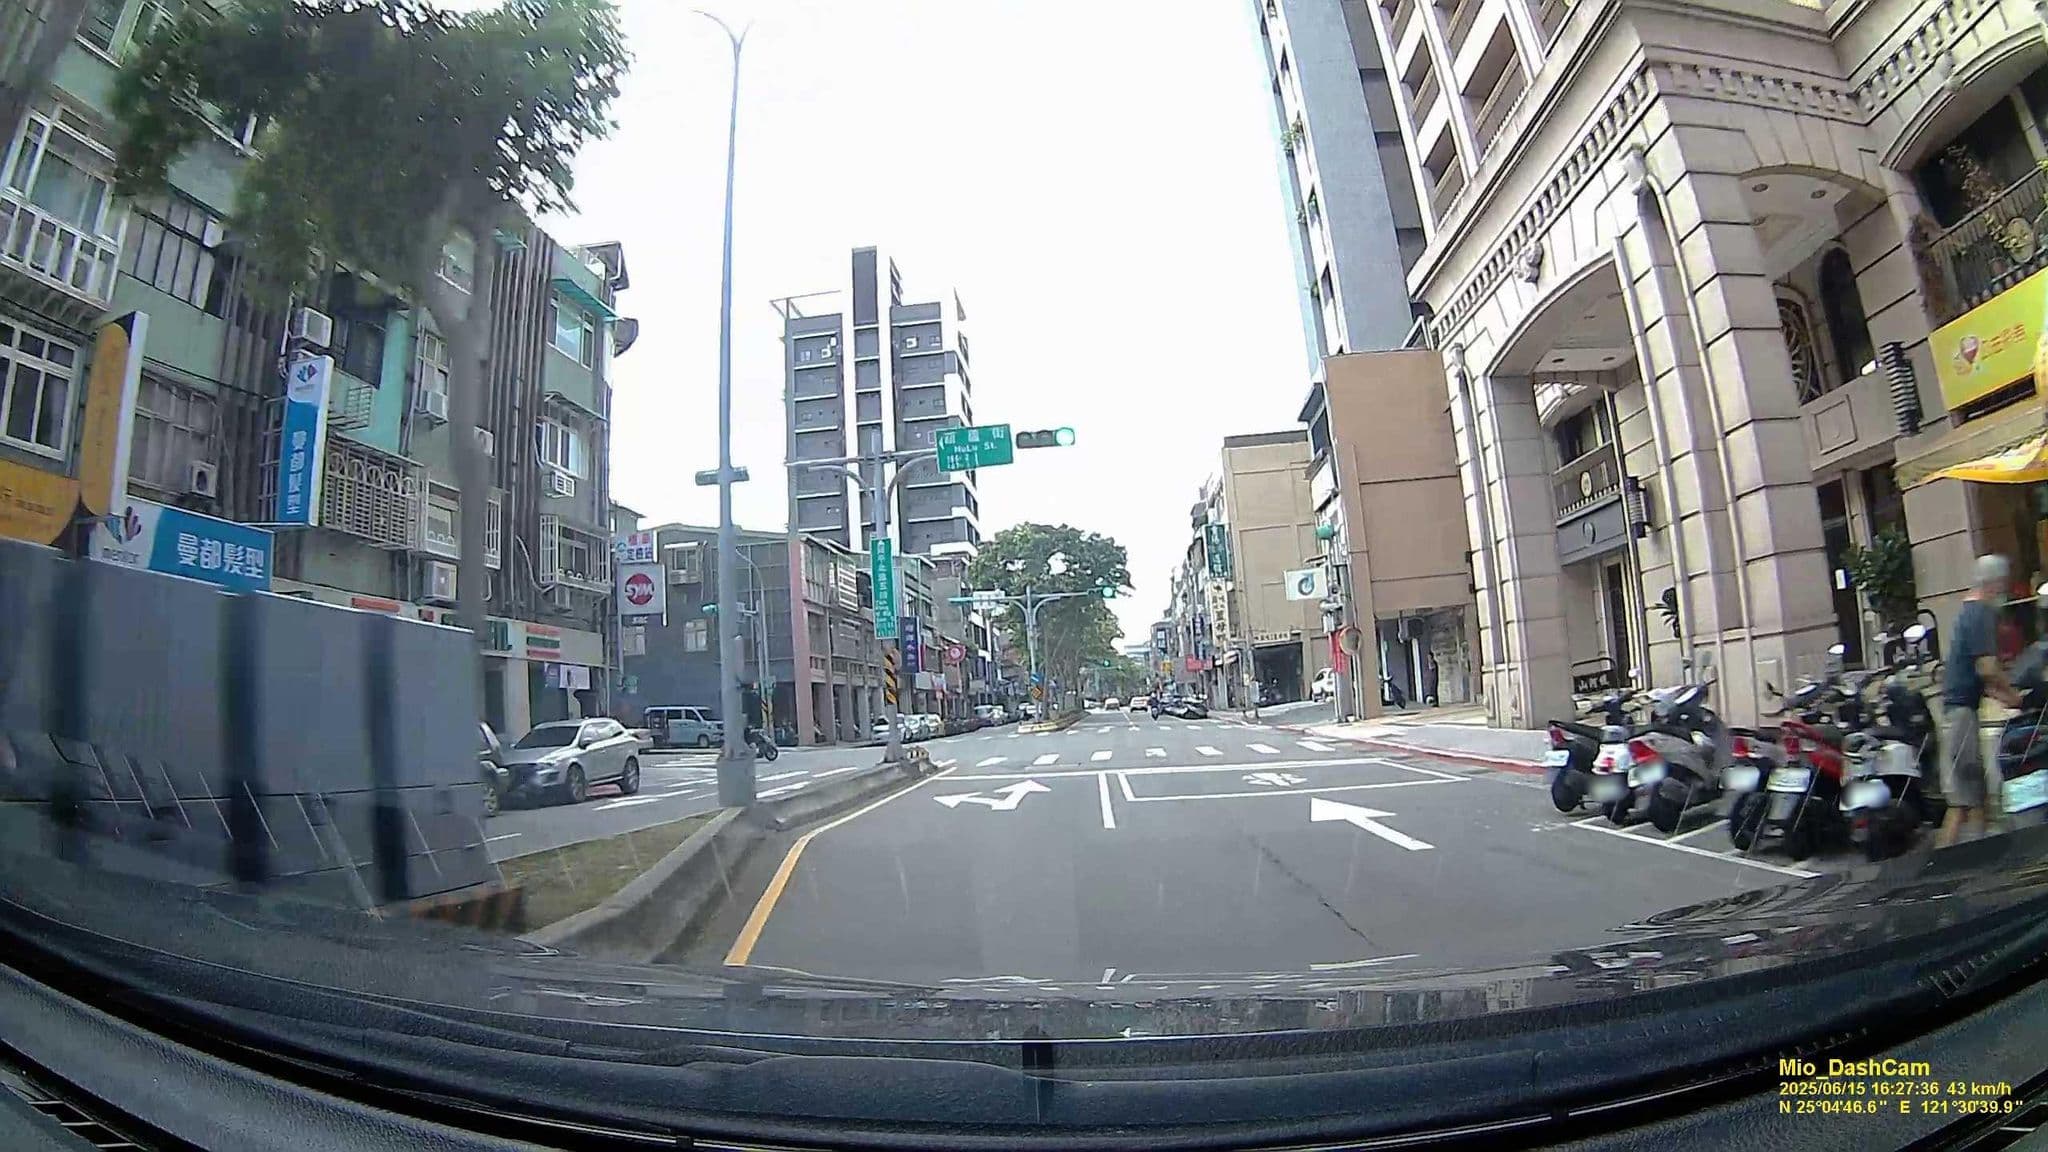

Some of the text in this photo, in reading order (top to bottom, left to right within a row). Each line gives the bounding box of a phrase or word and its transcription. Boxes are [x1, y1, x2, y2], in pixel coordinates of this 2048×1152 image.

[177, 532, 265, 579] 曼都髮型
[625, 583, 654, 600] SYM
